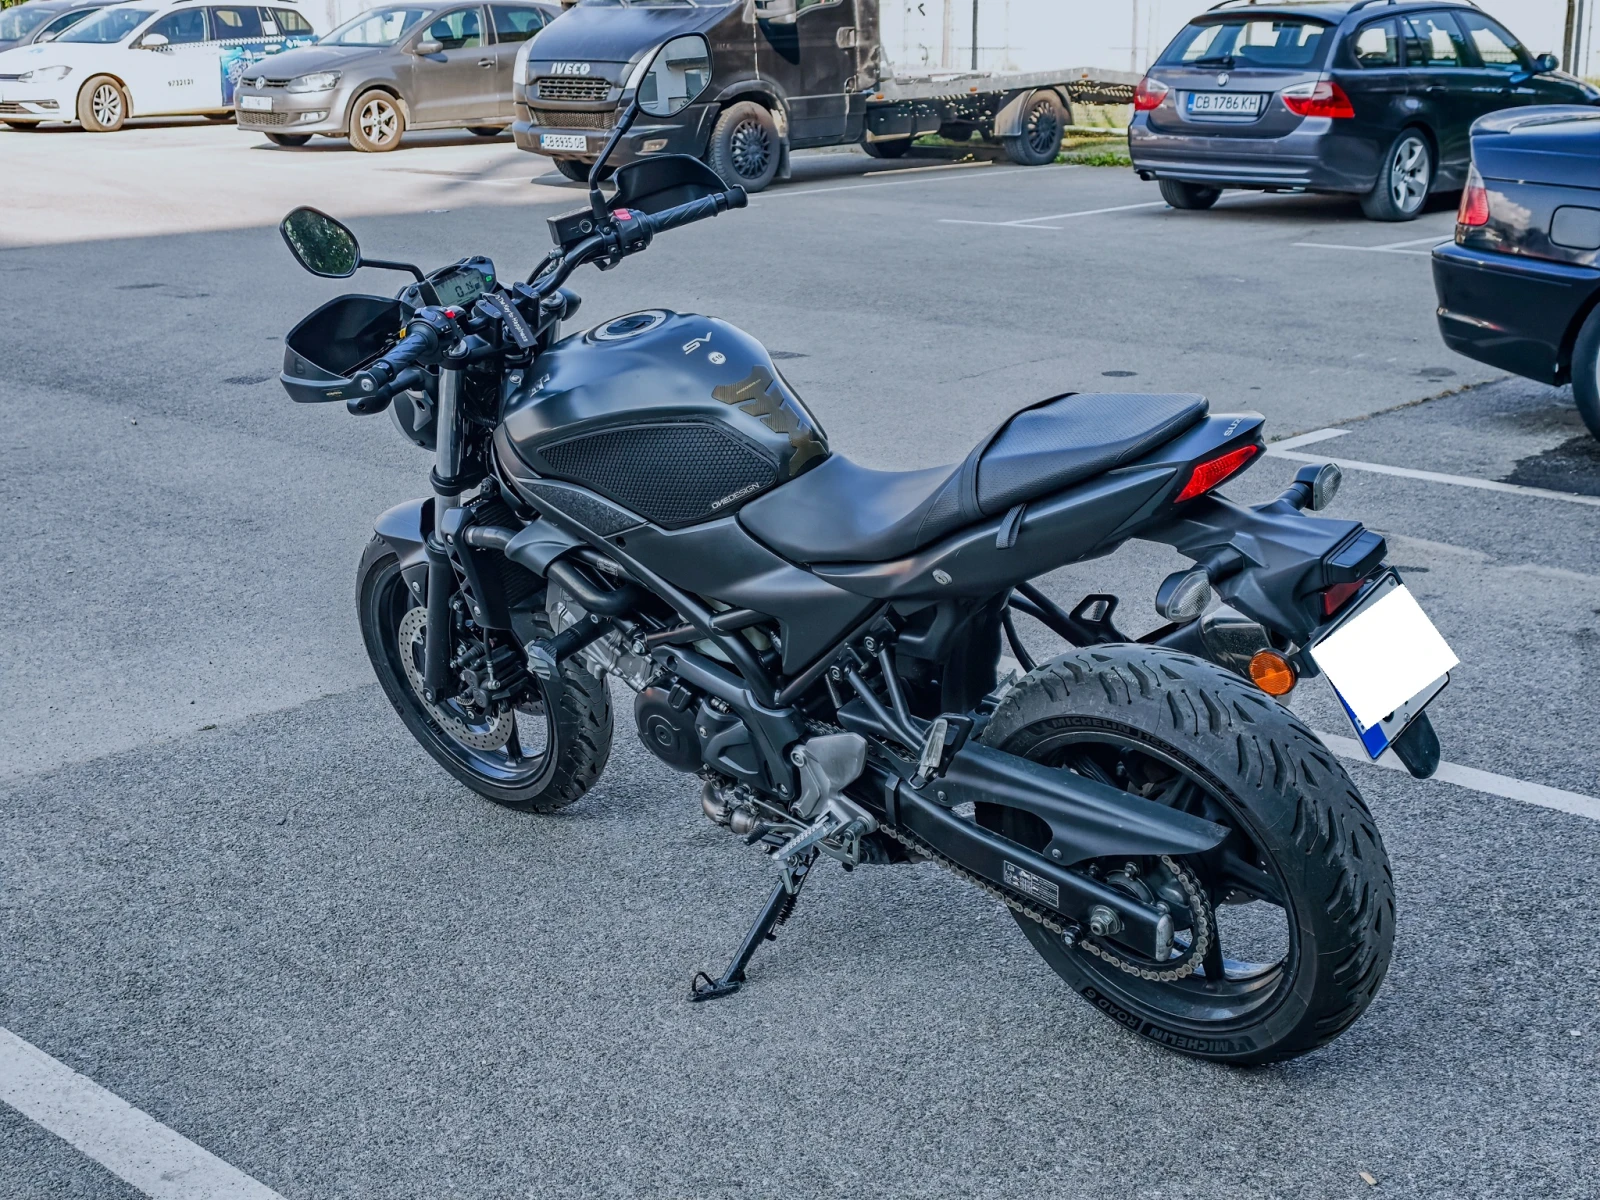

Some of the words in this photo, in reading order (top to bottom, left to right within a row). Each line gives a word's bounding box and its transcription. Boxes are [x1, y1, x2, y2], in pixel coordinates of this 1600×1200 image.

[551, 62, 590, 75] IVECO
[1195, 95, 1210, 109] CB
[1214, 96, 1239, 109] 1786
[1241, 96, 1257, 110] KH
[512, 317, 528, 341] Happiness
[682, 331, 712, 355] SV
[1224, 416, 1246, 437] SUZ
[711, 482, 760, 509] ONEDESIGN
[1051, 717, 1131, 733] MICHELIN
[1085, 989, 1097, 999] 6
[1098, 998, 1138, 1027] ROAD
[1148, 1028, 1229, 1052] MICHELIN
